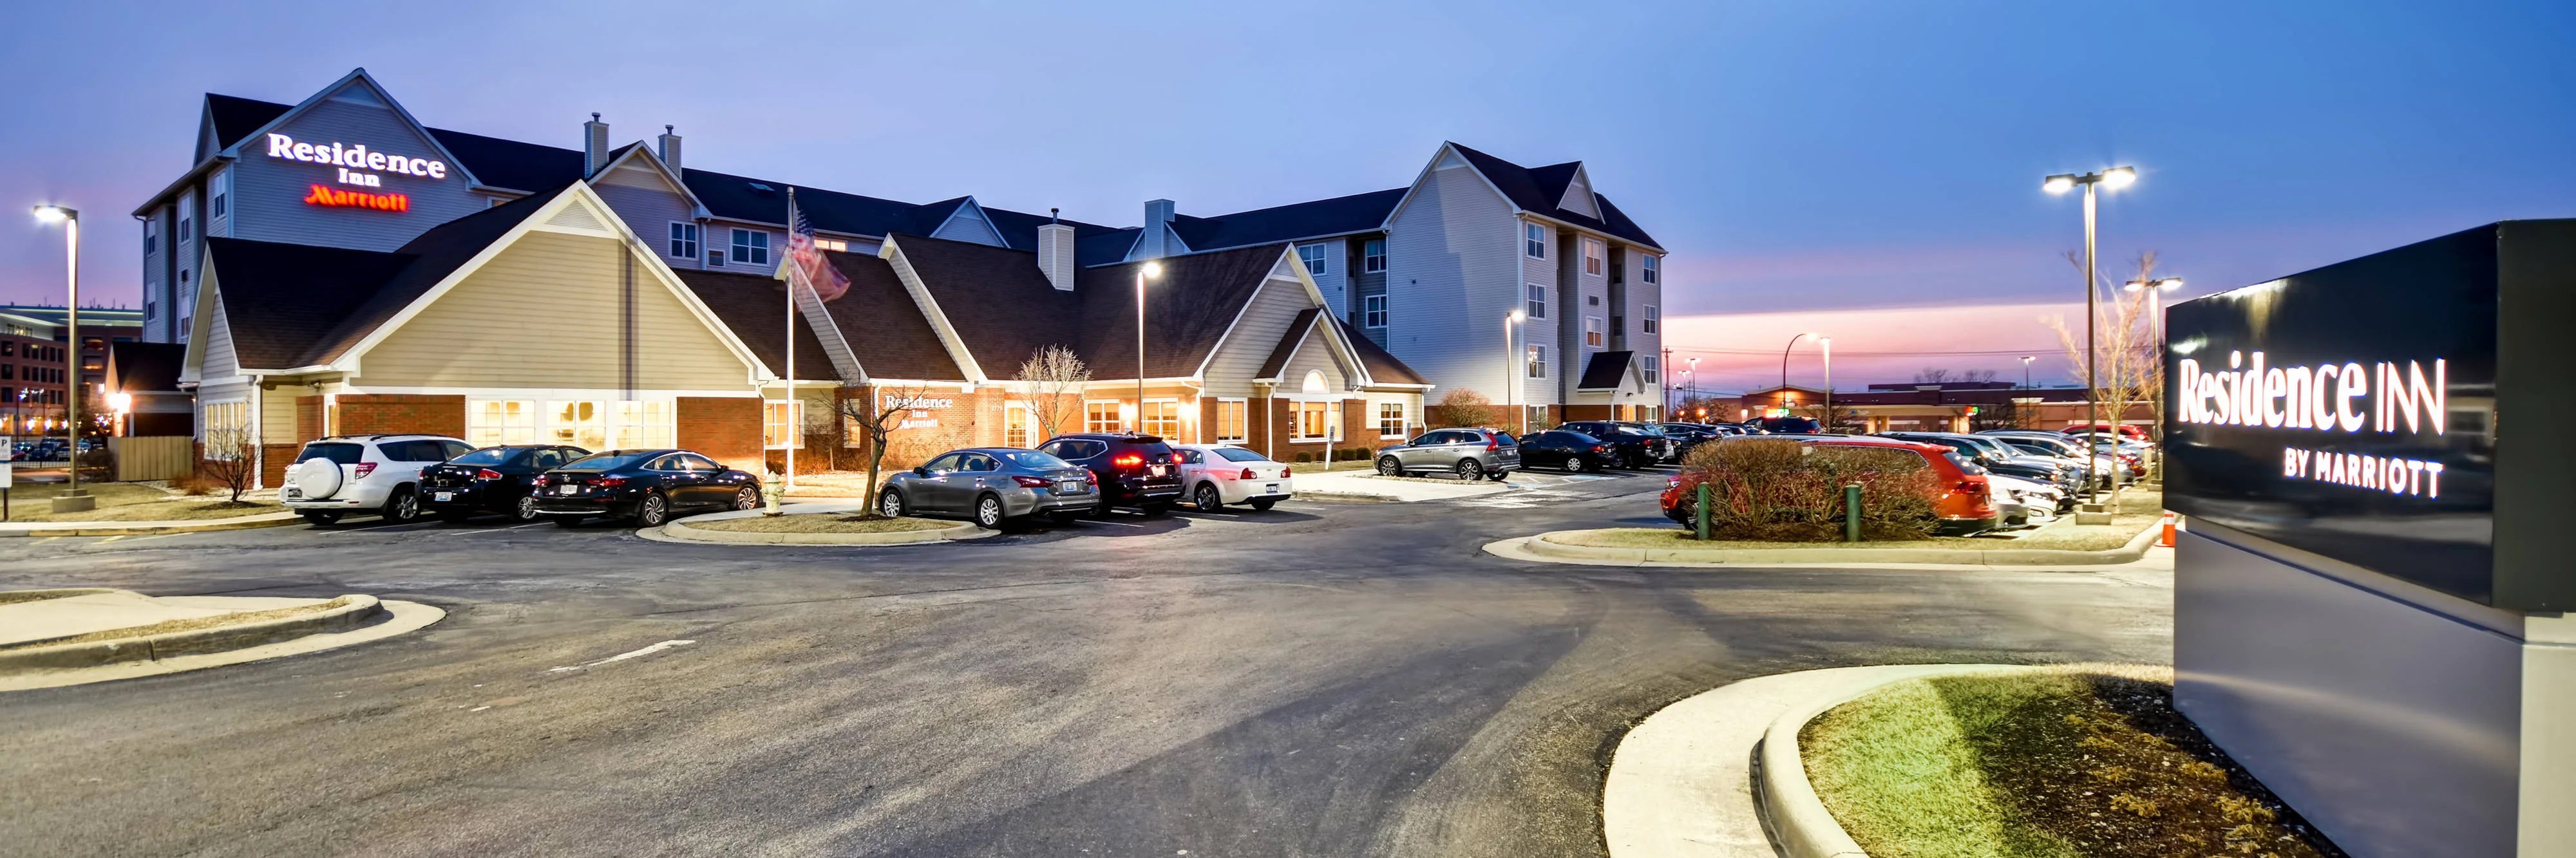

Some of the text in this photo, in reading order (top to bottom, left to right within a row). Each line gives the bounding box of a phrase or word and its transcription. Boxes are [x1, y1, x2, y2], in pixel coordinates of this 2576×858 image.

[267, 133, 446, 179] Residence
[337, 167, 381, 187] Inn
[304, 184, 410, 212] Marriott
[885, 395, 953, 409] Residence
[2179, 350, 2446, 436] Residence INN
[898, 419, 938, 429] Marriott
[2284, 447, 2445, 499] BY MARRIOTT
